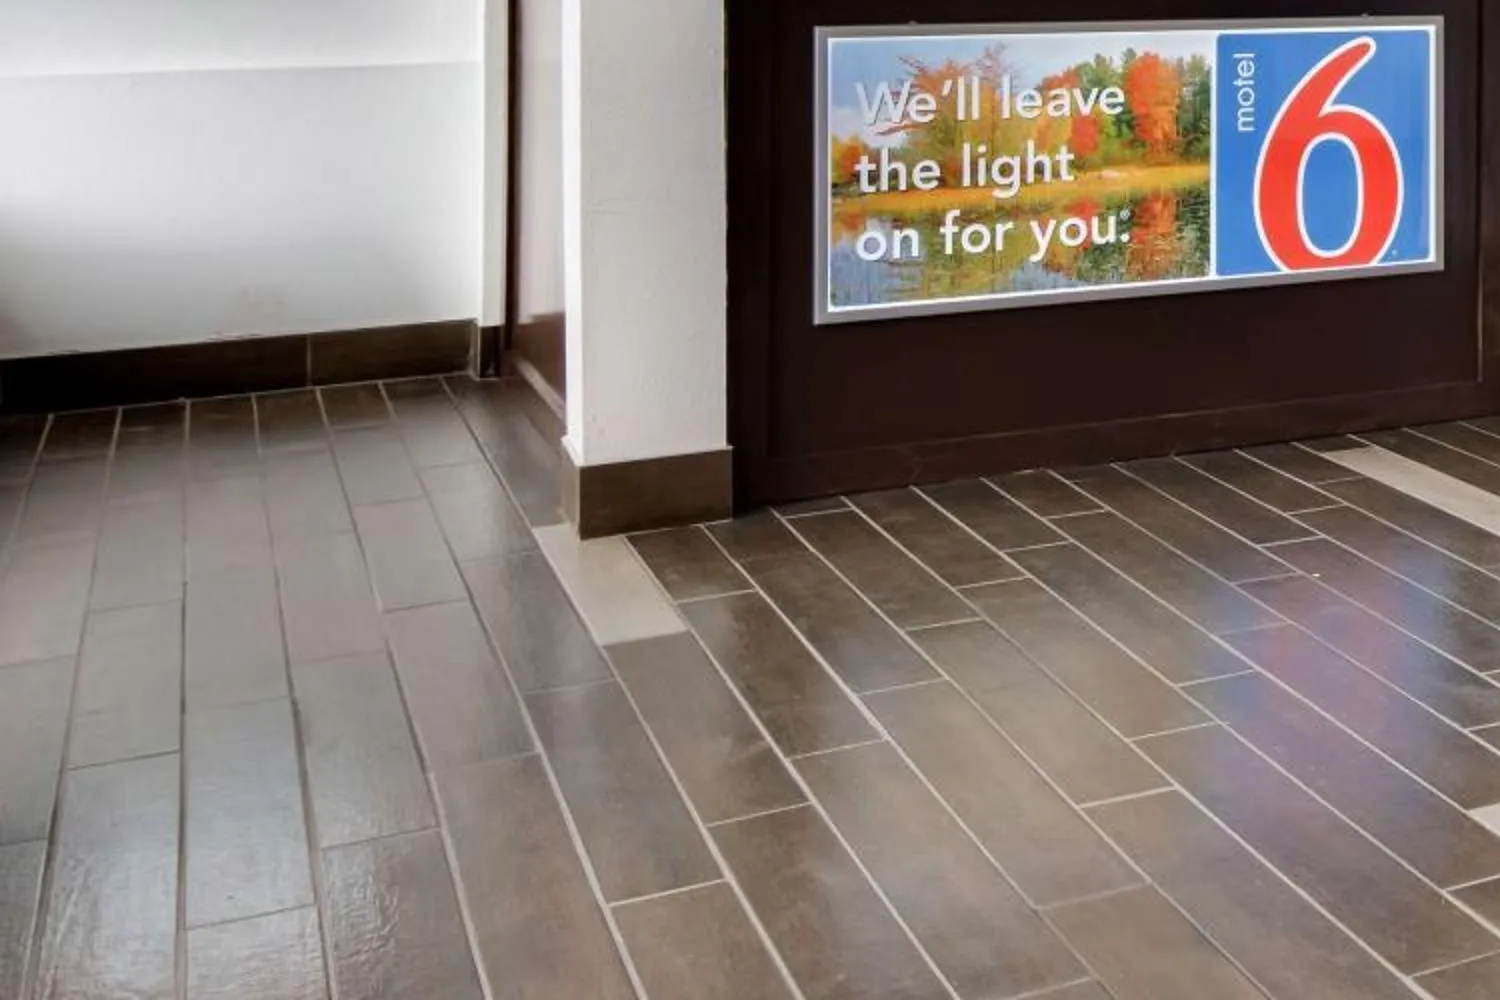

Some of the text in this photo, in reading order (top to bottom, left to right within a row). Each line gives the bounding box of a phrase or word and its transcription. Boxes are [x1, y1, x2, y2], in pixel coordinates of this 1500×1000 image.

[855, 74, 1125, 125] We’ll leave
[1232, 53, 1256, 132] motel
[854, 139, 1075, 199] the light
[1253, 36, 1404, 272] 6
[855, 226, 920, 261] on
[939, 209, 1013, 255] for
